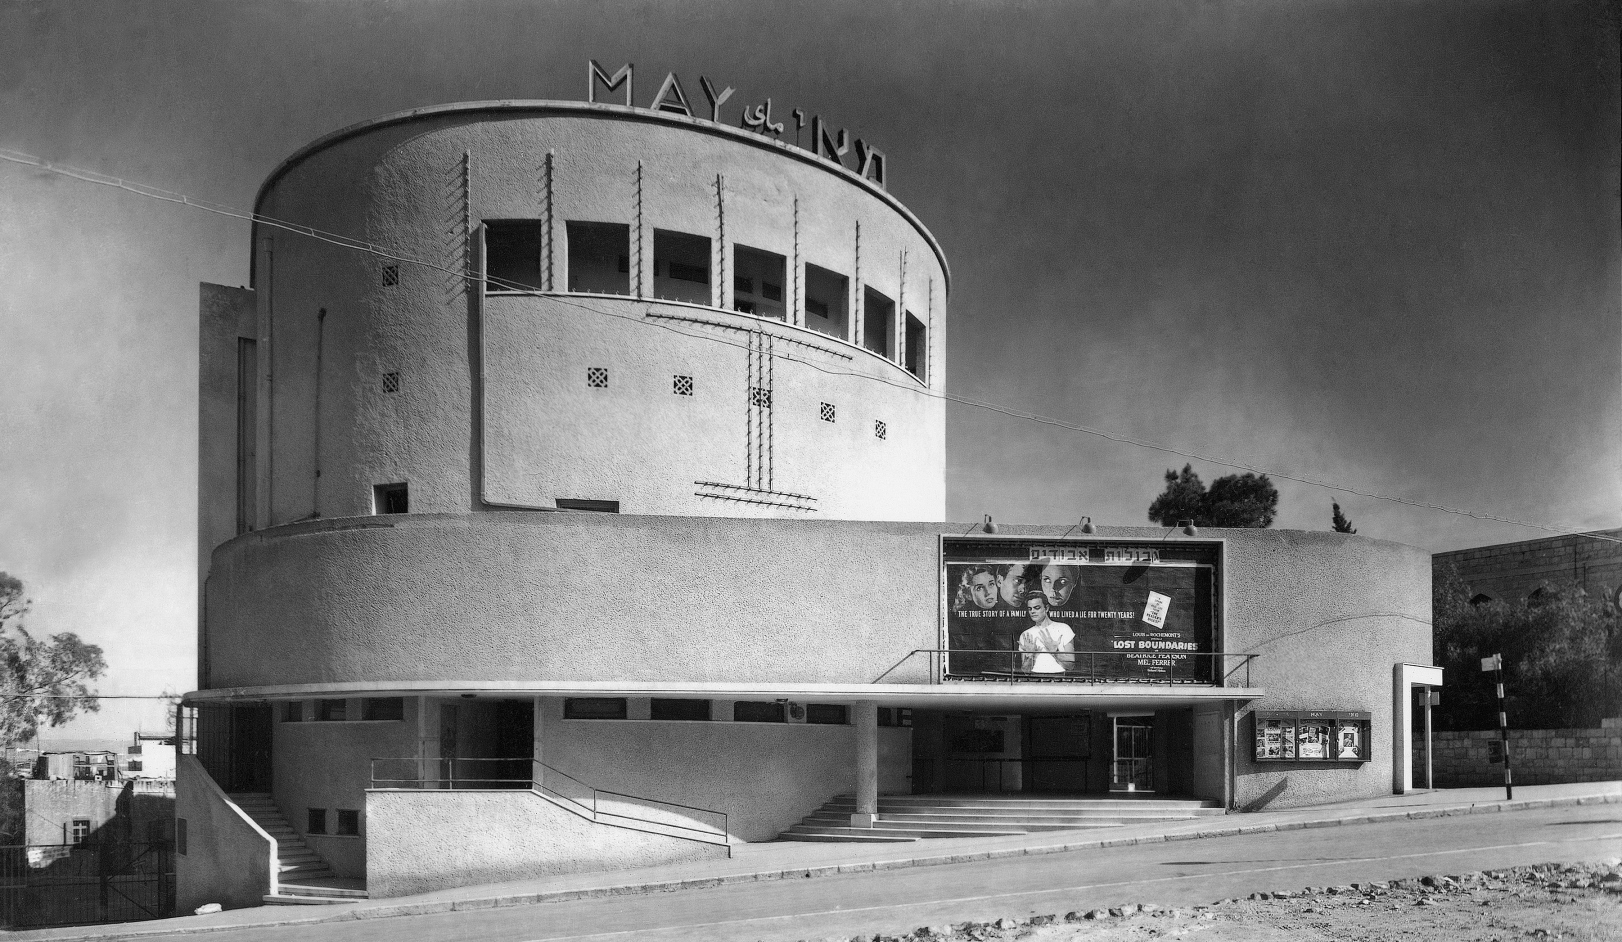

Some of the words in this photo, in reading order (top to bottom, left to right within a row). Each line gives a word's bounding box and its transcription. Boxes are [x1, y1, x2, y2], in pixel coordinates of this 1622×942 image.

[588, 59, 737, 124] MAY
[793, 107, 887, 192] מאי
[1031, 549, 1088, 561] אבודים
[1105, 549, 1159, 562] גבולות
[958, 610, 968, 618] THE
[969, 610, 981, 618] TRUE
[982, 610, 998, 618] STORY
[1000, 610, 1006, 618] OF
[1010, 610, 1027, 618] FAMILY
[1049, 610, 1060, 618] WHO
[1061, 610, 1075, 618] LIVED
[1098, 611, 1117, 619] TWENTY
[1118, 611, 1135, 619] YEARS!
